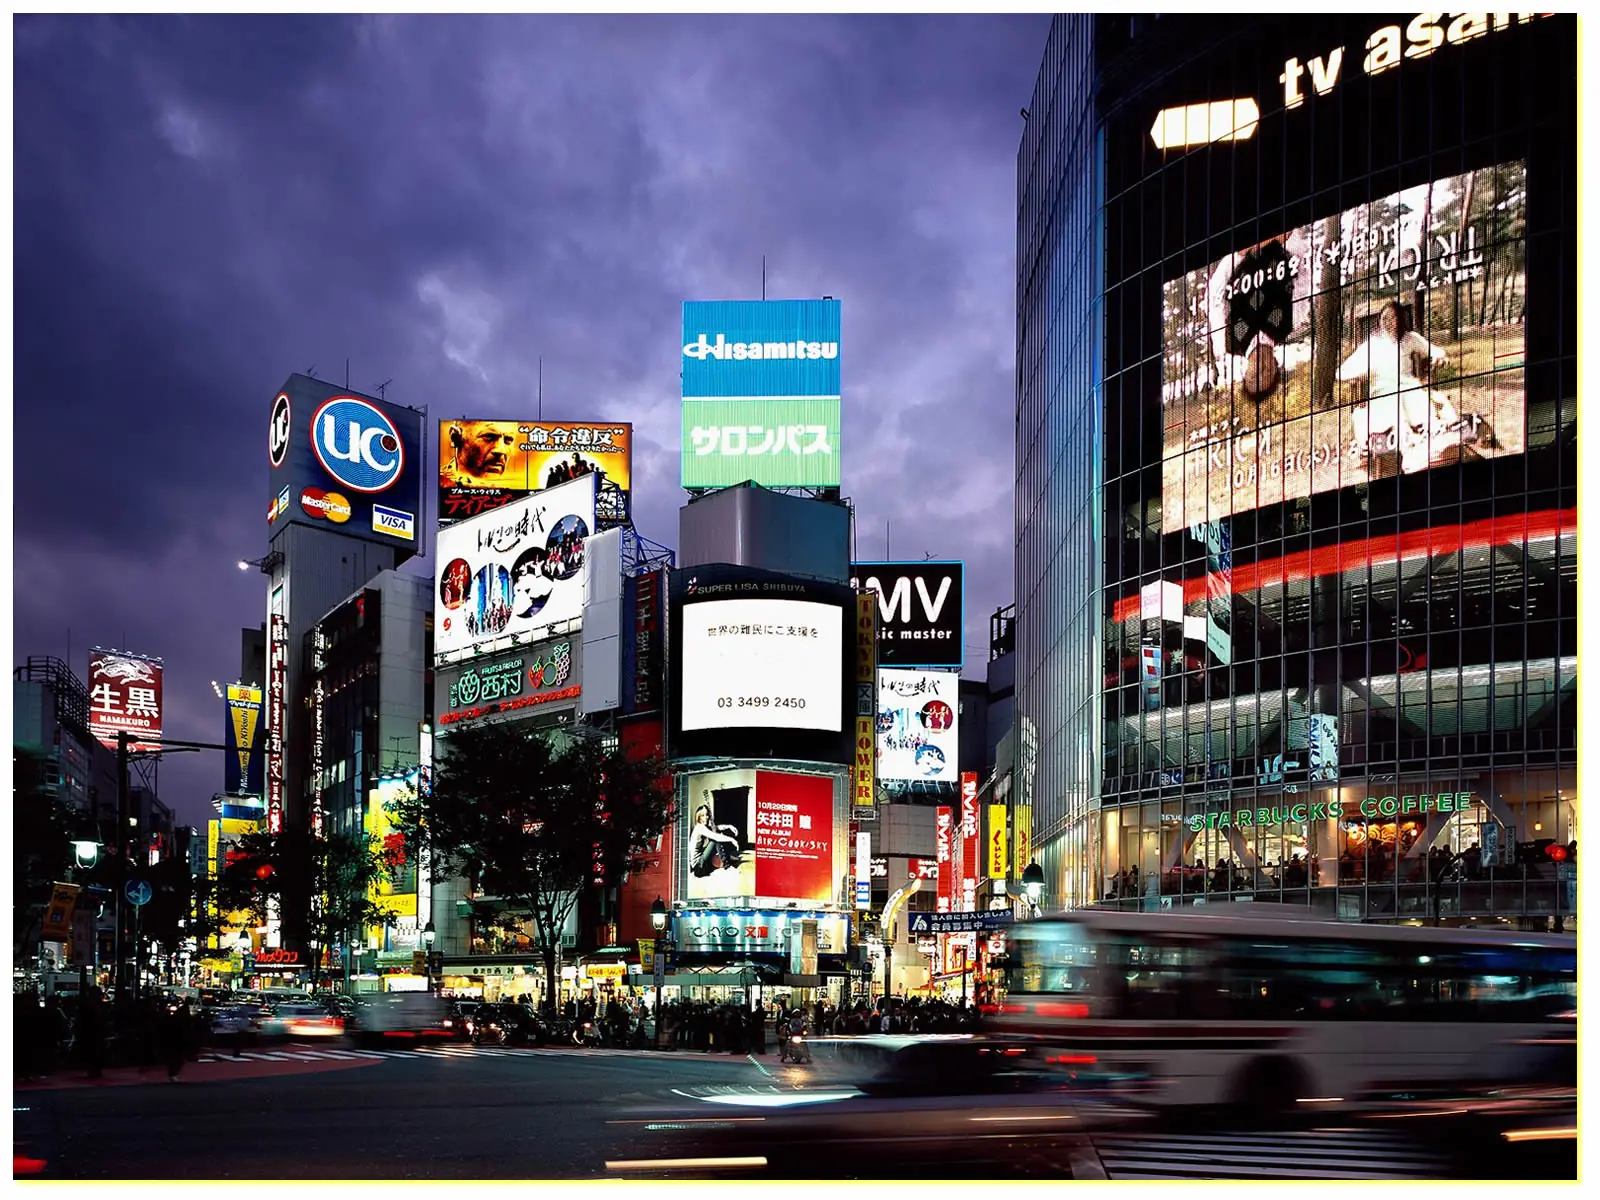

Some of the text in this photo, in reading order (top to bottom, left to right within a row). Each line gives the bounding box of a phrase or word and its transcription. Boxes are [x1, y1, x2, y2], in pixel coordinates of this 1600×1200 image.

[1280, 13, 1555, 109] tv asa
[683, 334, 838, 360] Hisamitsu
[691, 425, 832, 455] サロンパス
[301, 495, 351, 516] MasterCard
[380, 514, 406, 530] VISA
[698, 584, 732, 594] SUPER
[763, 583, 806, 592] SHIBUYA
[850, 576, 952, 623] MV
[858, 599, 872, 677] TOKYO
[900, 628, 953, 640] master
[90, 683, 159, 719] 生黒
[717, 697, 806, 709] 03 3499 2450
[99, 715, 151, 727] NAMAKURO
[857, 720, 872, 799] TOWER
[757, 811, 794, 829] 矢井田
[963, 781, 977, 839] さくらや
[1189, 801, 1344, 832] STARBUCKS
[1360, 791, 1471, 818] COFFEE
[771, 829, 792, 837] ALBUM
[937, 814, 951, 864] さくらや
